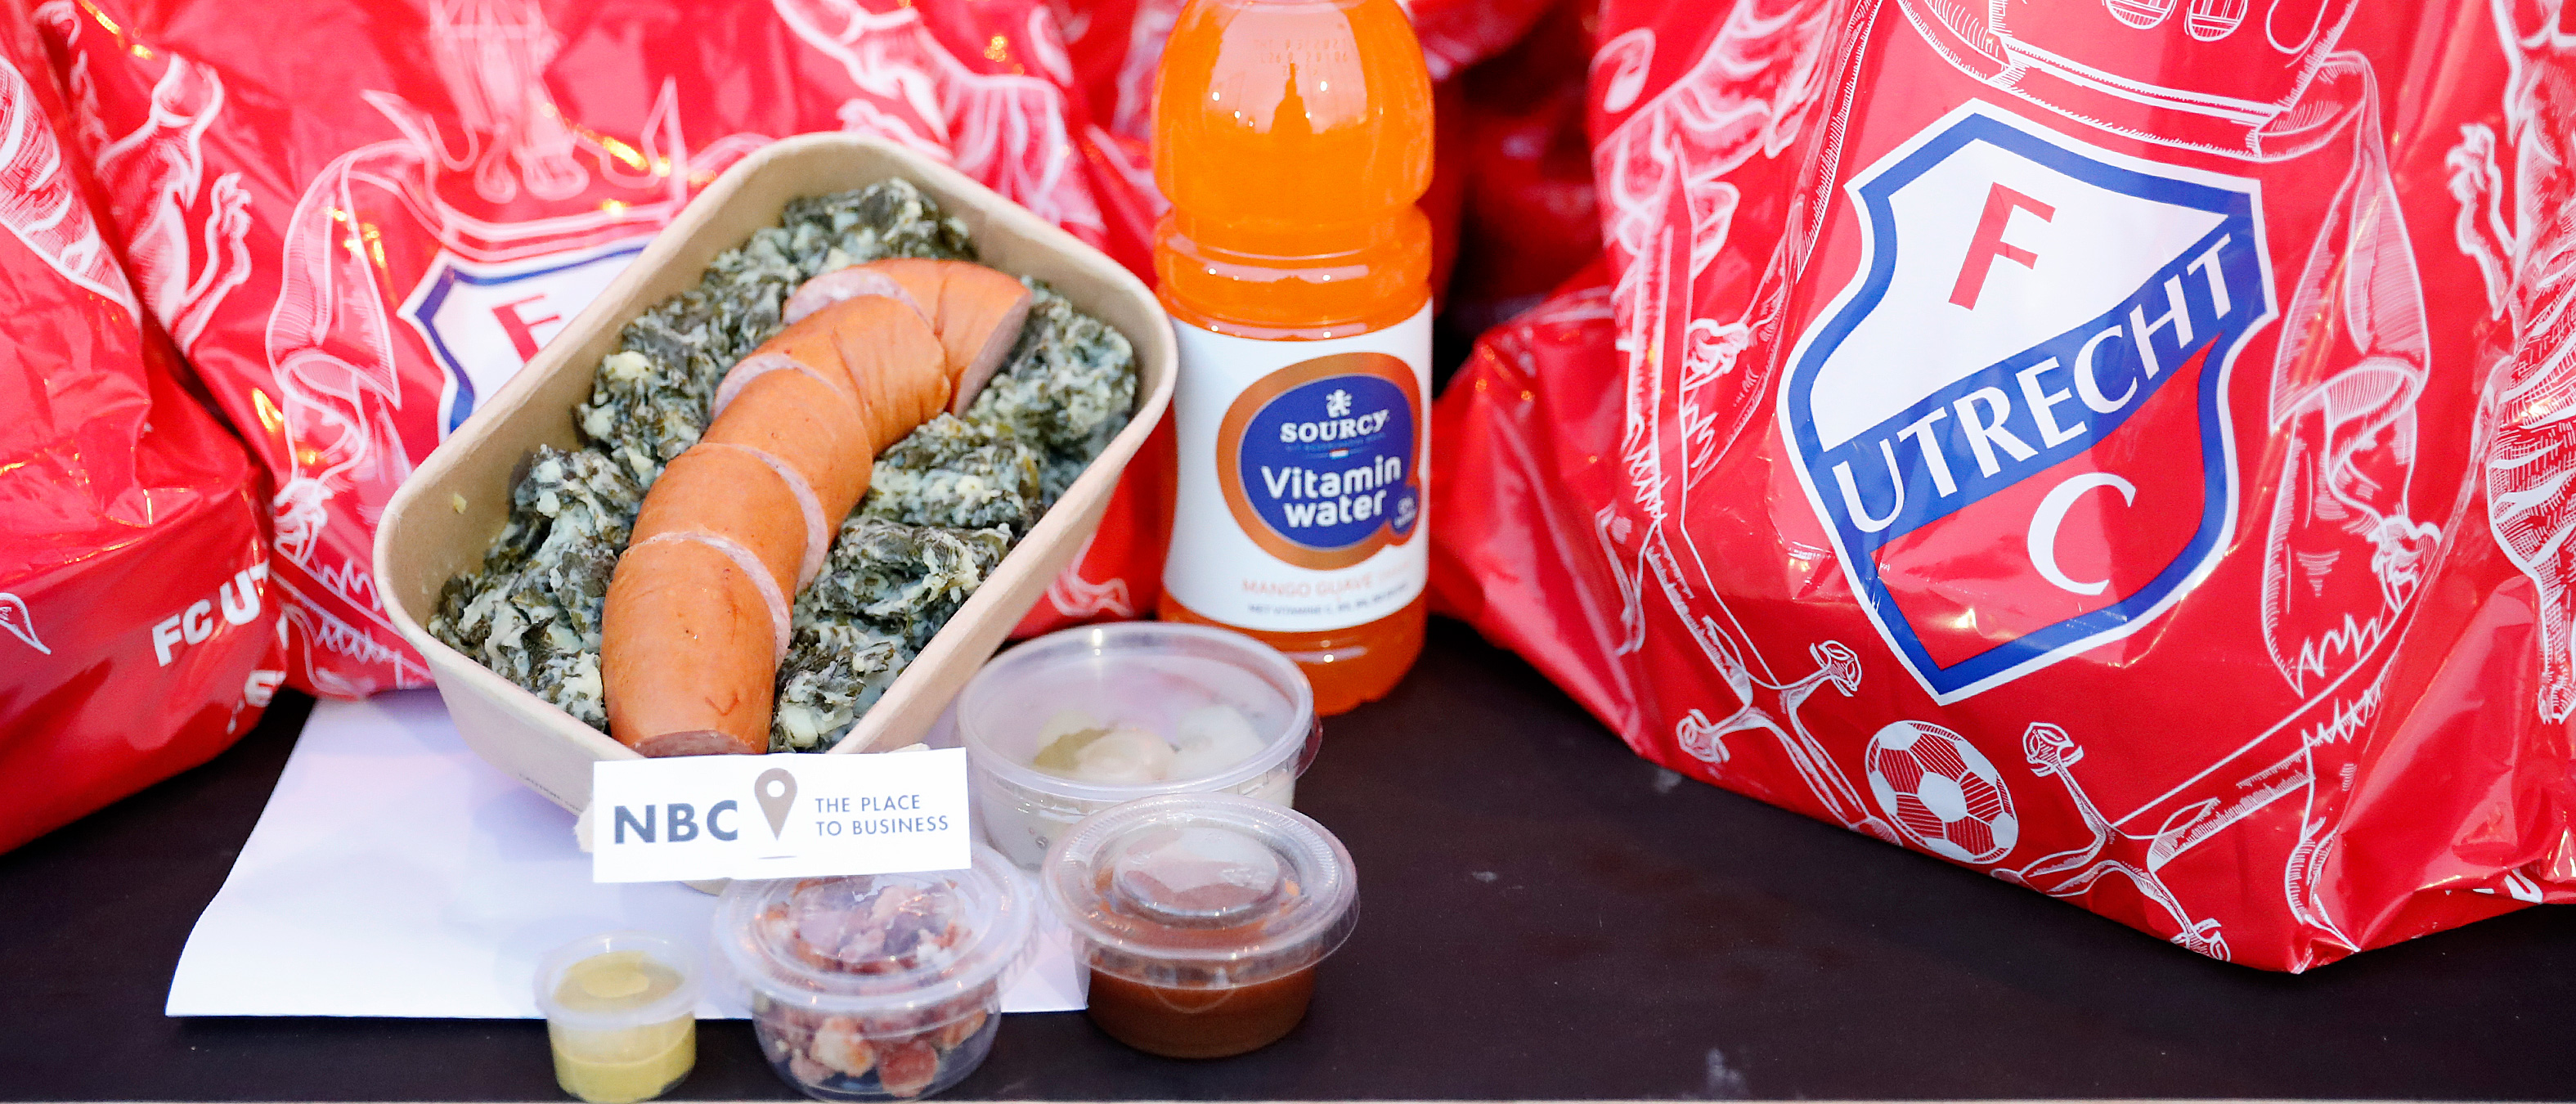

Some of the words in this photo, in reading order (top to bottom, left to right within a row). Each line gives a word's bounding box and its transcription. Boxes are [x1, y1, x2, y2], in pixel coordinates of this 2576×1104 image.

[1947, 181, 2056, 312] F
[491, 294, 560, 364] F
[1832, 232, 2232, 533] UTRECHT
[1279, 409, 1389, 443] SOURCY
[1260, 454, 1402, 500] Vitamin
[1282, 489, 1387, 528] water
[2026, 472, 2137, 595] C
[1242, 577, 1311, 597] MANGO
[1315, 572, 1372, 596] GUAVE
[152, 598, 213, 667] FC
[613, 800, 738, 845] NBC
[815, 797, 850, 814] THE
[862, 794, 921, 811] PLACE
[815, 820, 842, 837] TO
[852, 815, 949, 836] BUSINESS
